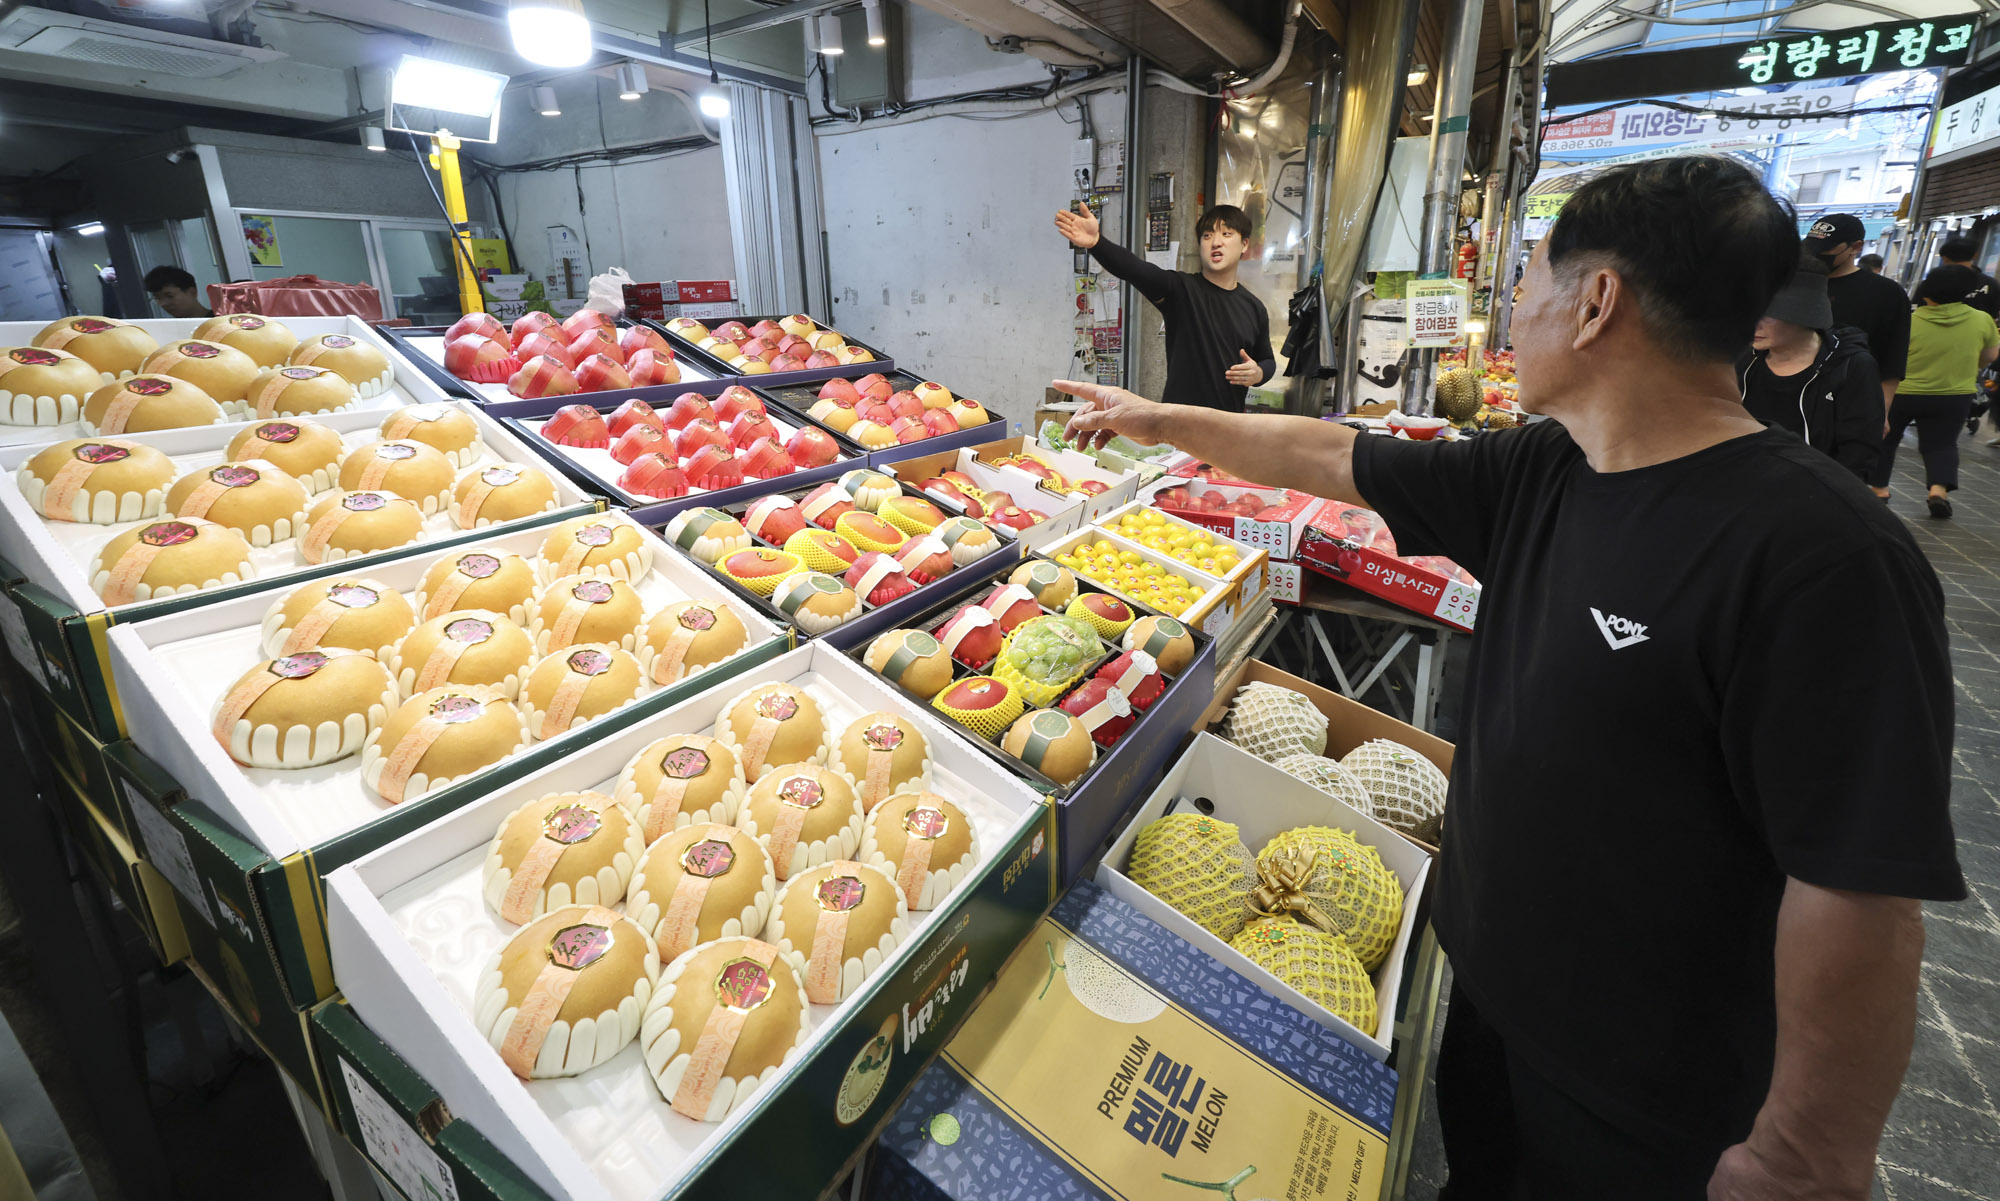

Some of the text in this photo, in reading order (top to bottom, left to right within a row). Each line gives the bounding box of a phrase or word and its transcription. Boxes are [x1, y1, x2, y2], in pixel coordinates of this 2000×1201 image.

[1415, 301, 1459, 316] 환급행사
[1415, 316, 1458, 331] 참여점포
[1605, 614, 1649, 638] PONY
[1097, 1035, 1151, 1120] PREMIUM
[1123, 1051, 1206, 1159] 멜론
[1190, 1087, 1228, 1154] MELON
[1356, 1139, 1366, 1158] GIFT
[1350, 1158, 1363, 1185] MELON
